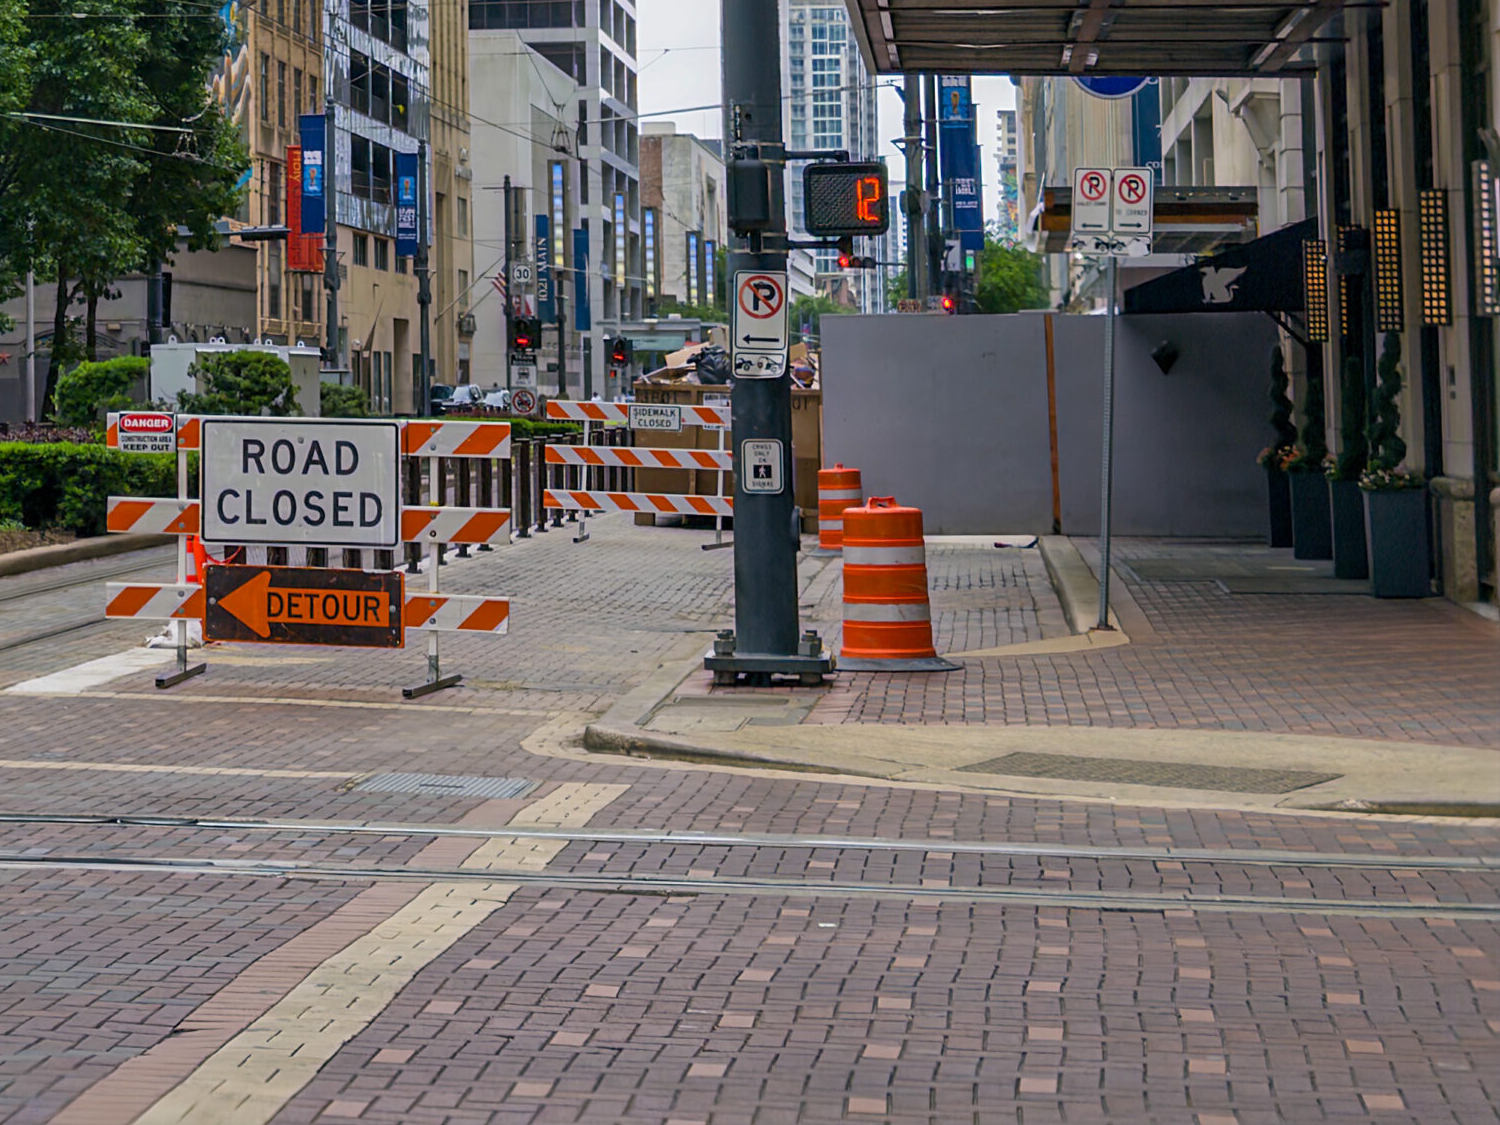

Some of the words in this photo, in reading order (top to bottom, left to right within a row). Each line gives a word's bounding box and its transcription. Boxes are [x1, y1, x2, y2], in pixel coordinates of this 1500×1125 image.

[856, 177, 881, 222] 12
[536, 237, 548, 273] MAIN
[516, 268, 530, 280] 30
[537, 278, 548, 302] 1021
[124, 418, 169, 428] DANGER
[633, 407, 677, 419] SIDEWALK
[637, 418, 672, 428] CLOSED
[122, 443, 148, 451] KEEP
[150, 443, 170, 451] OUT
[242, 437, 360, 476] ROAD
[216, 488, 383, 528] CLOSED
[267, 591, 381, 623] DETOUR
